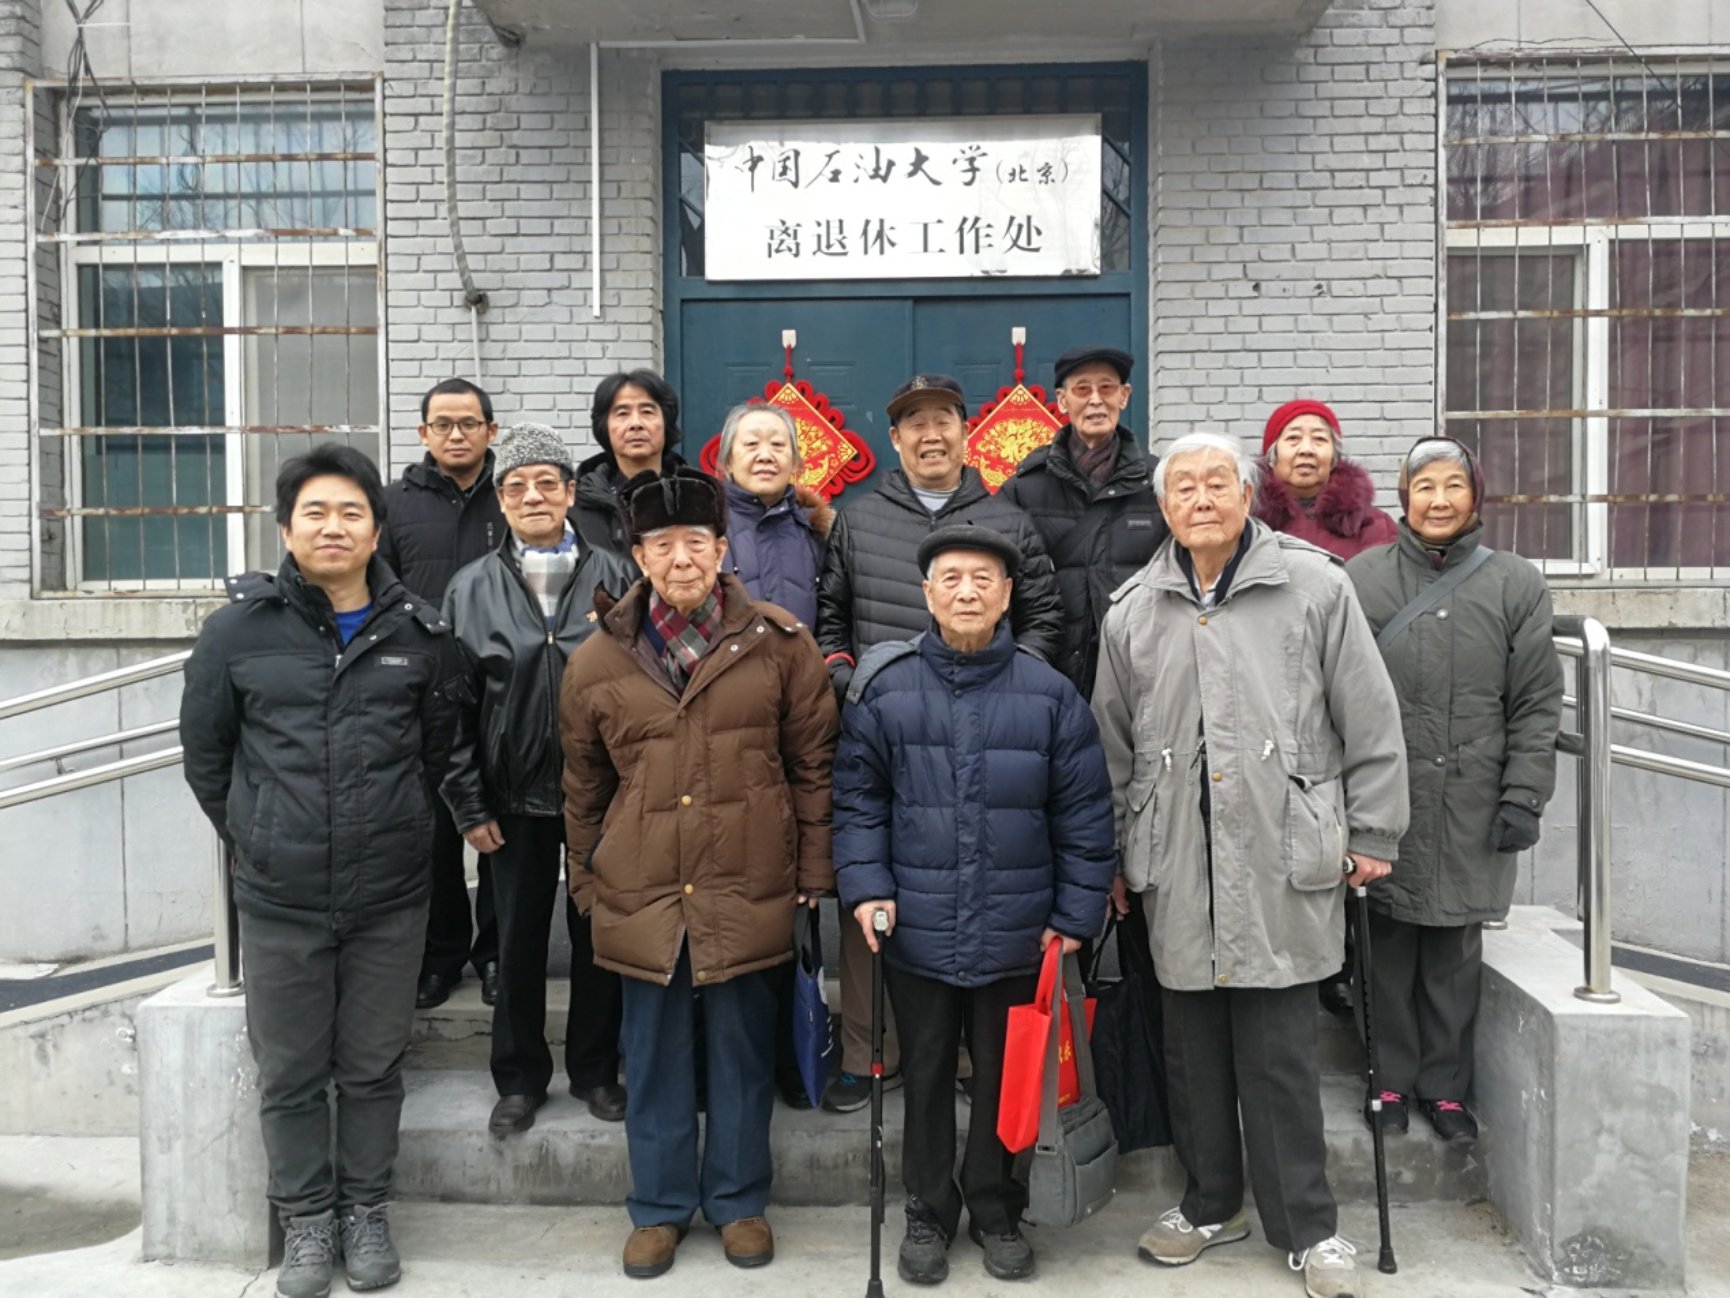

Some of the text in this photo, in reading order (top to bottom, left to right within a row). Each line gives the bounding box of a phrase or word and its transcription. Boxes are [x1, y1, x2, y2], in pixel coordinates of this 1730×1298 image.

[765, 215, 1043, 258] 离退休工作处
